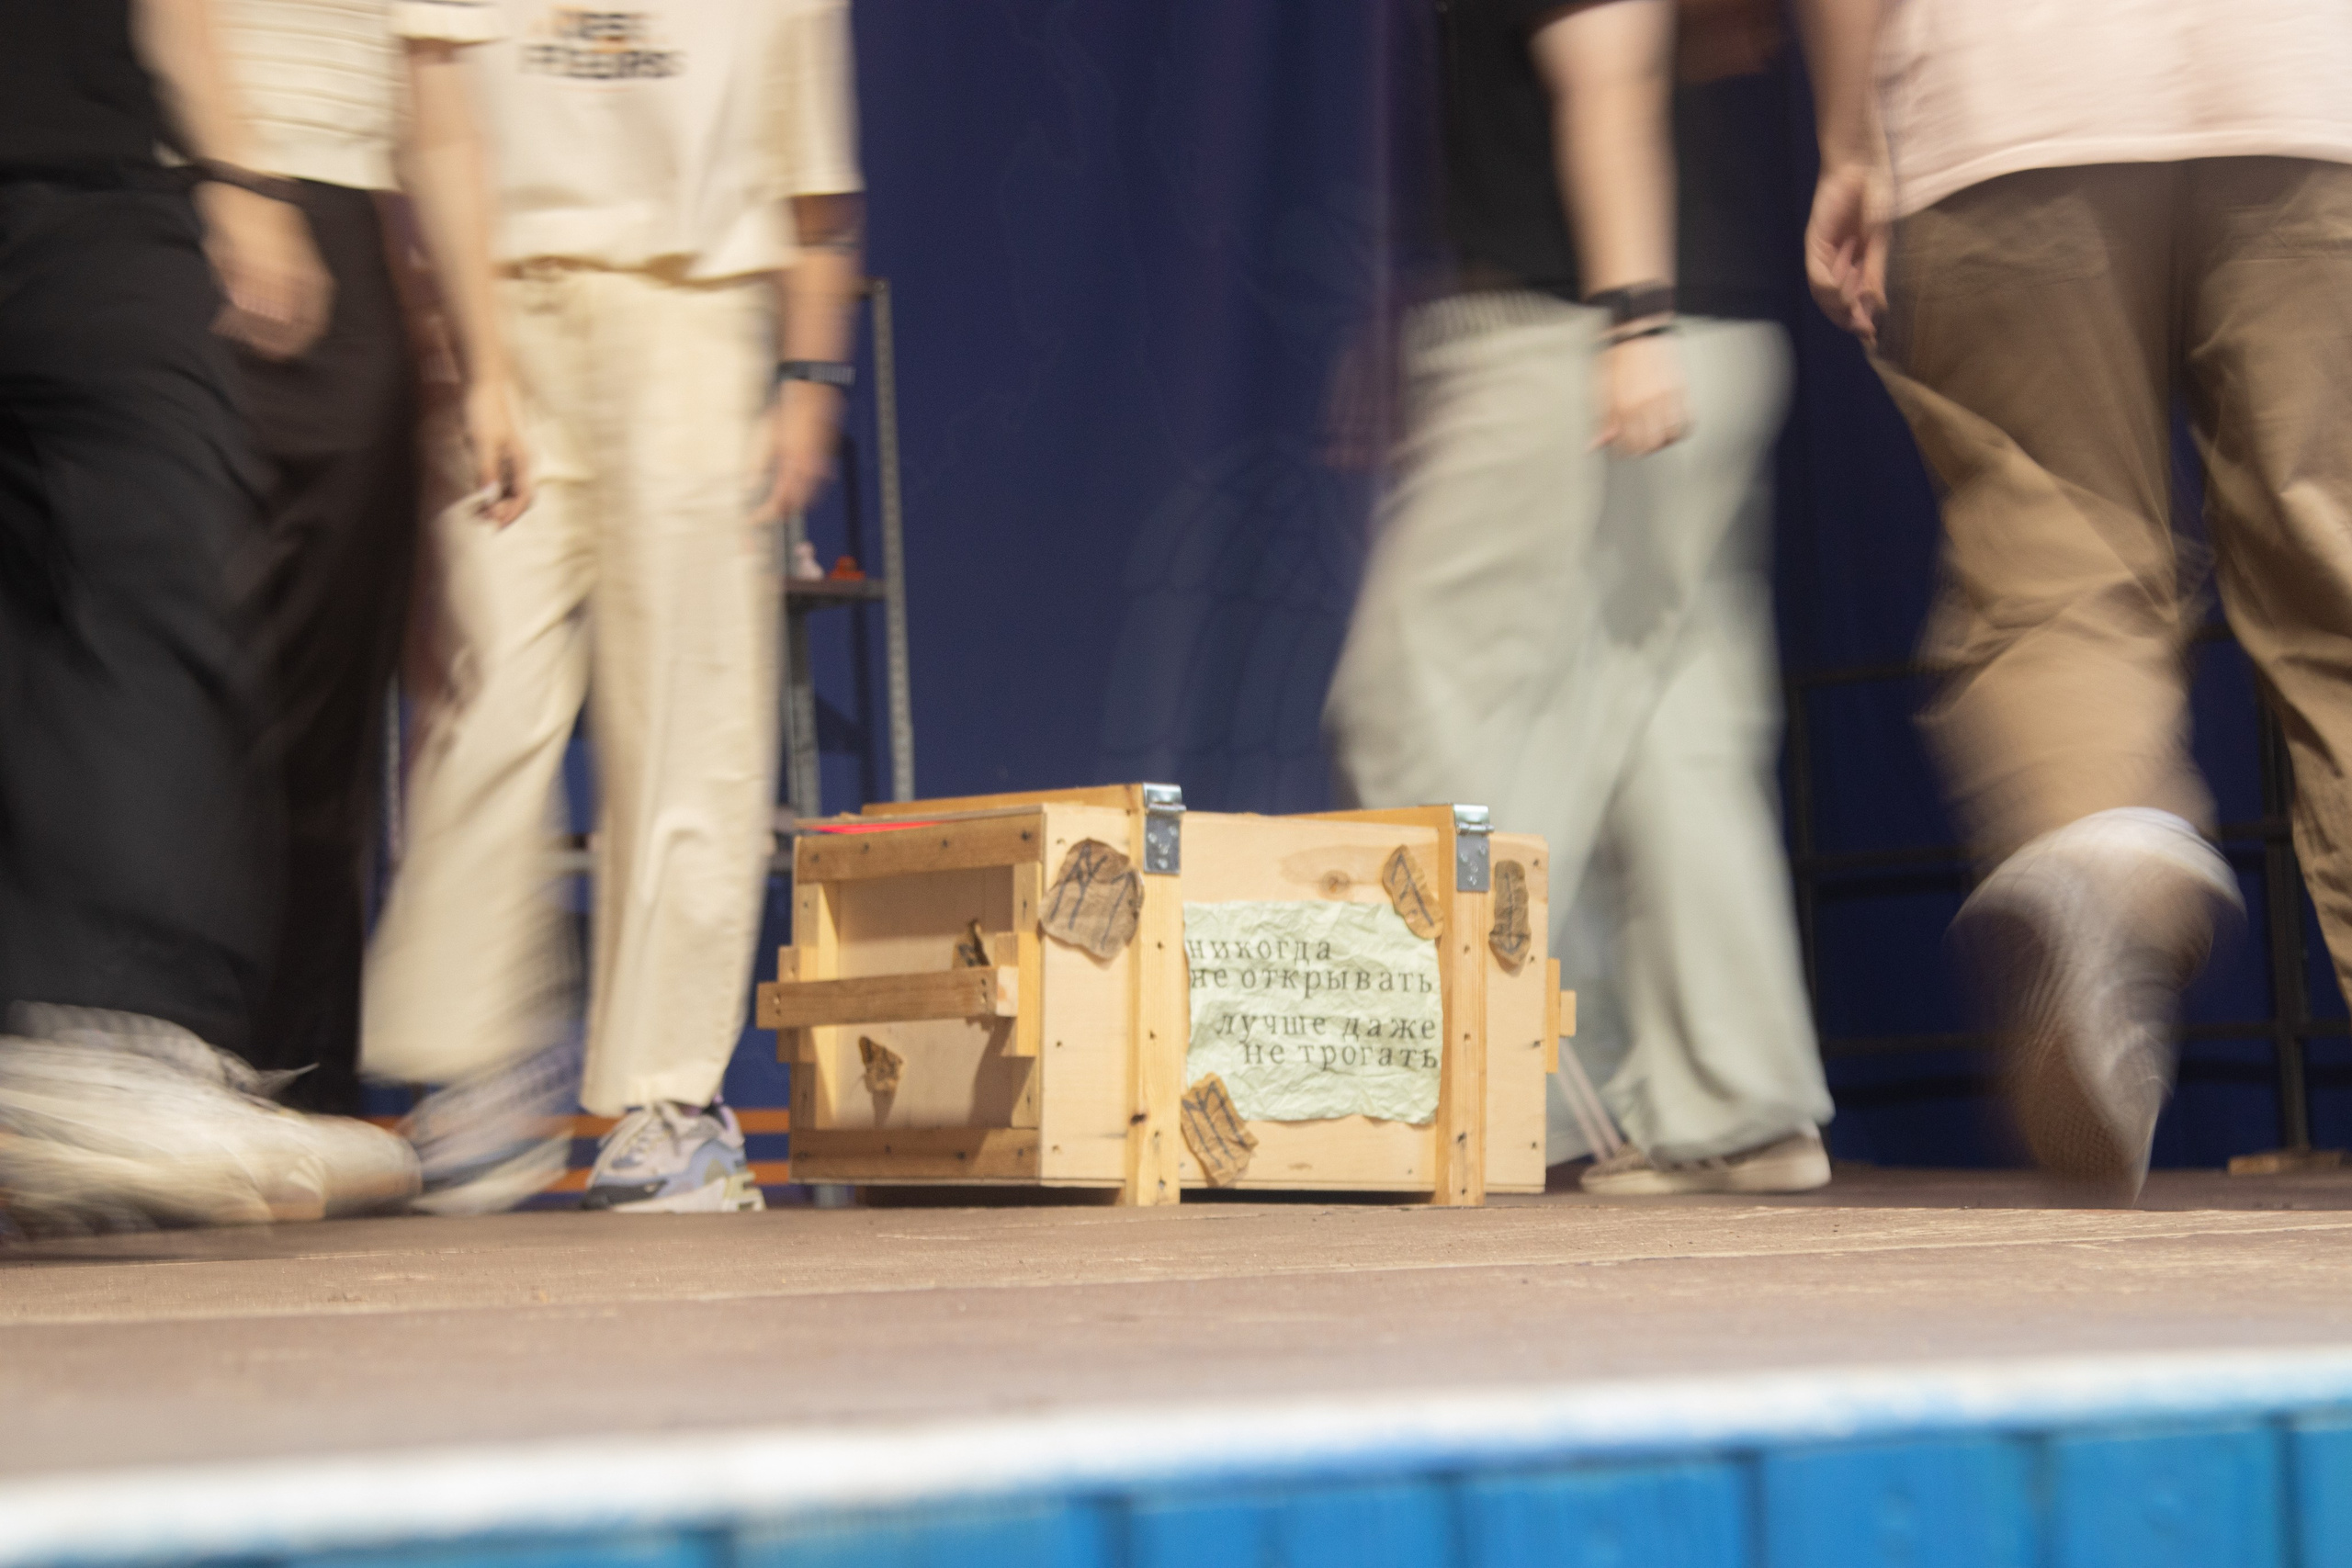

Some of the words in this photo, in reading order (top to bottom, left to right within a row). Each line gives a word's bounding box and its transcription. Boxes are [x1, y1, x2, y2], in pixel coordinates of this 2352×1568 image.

[1186, 939, 1331, 964] никогда
[1191, 968, 1228, 988] не
[1241, 969, 1433, 998] открывать
[1216, 1013, 1327, 1044] лучше
[1342, 1016, 1437, 1042] даже
[1243, 1043, 1285, 1066] не
[1297, 1045, 1439, 1071] трогать
